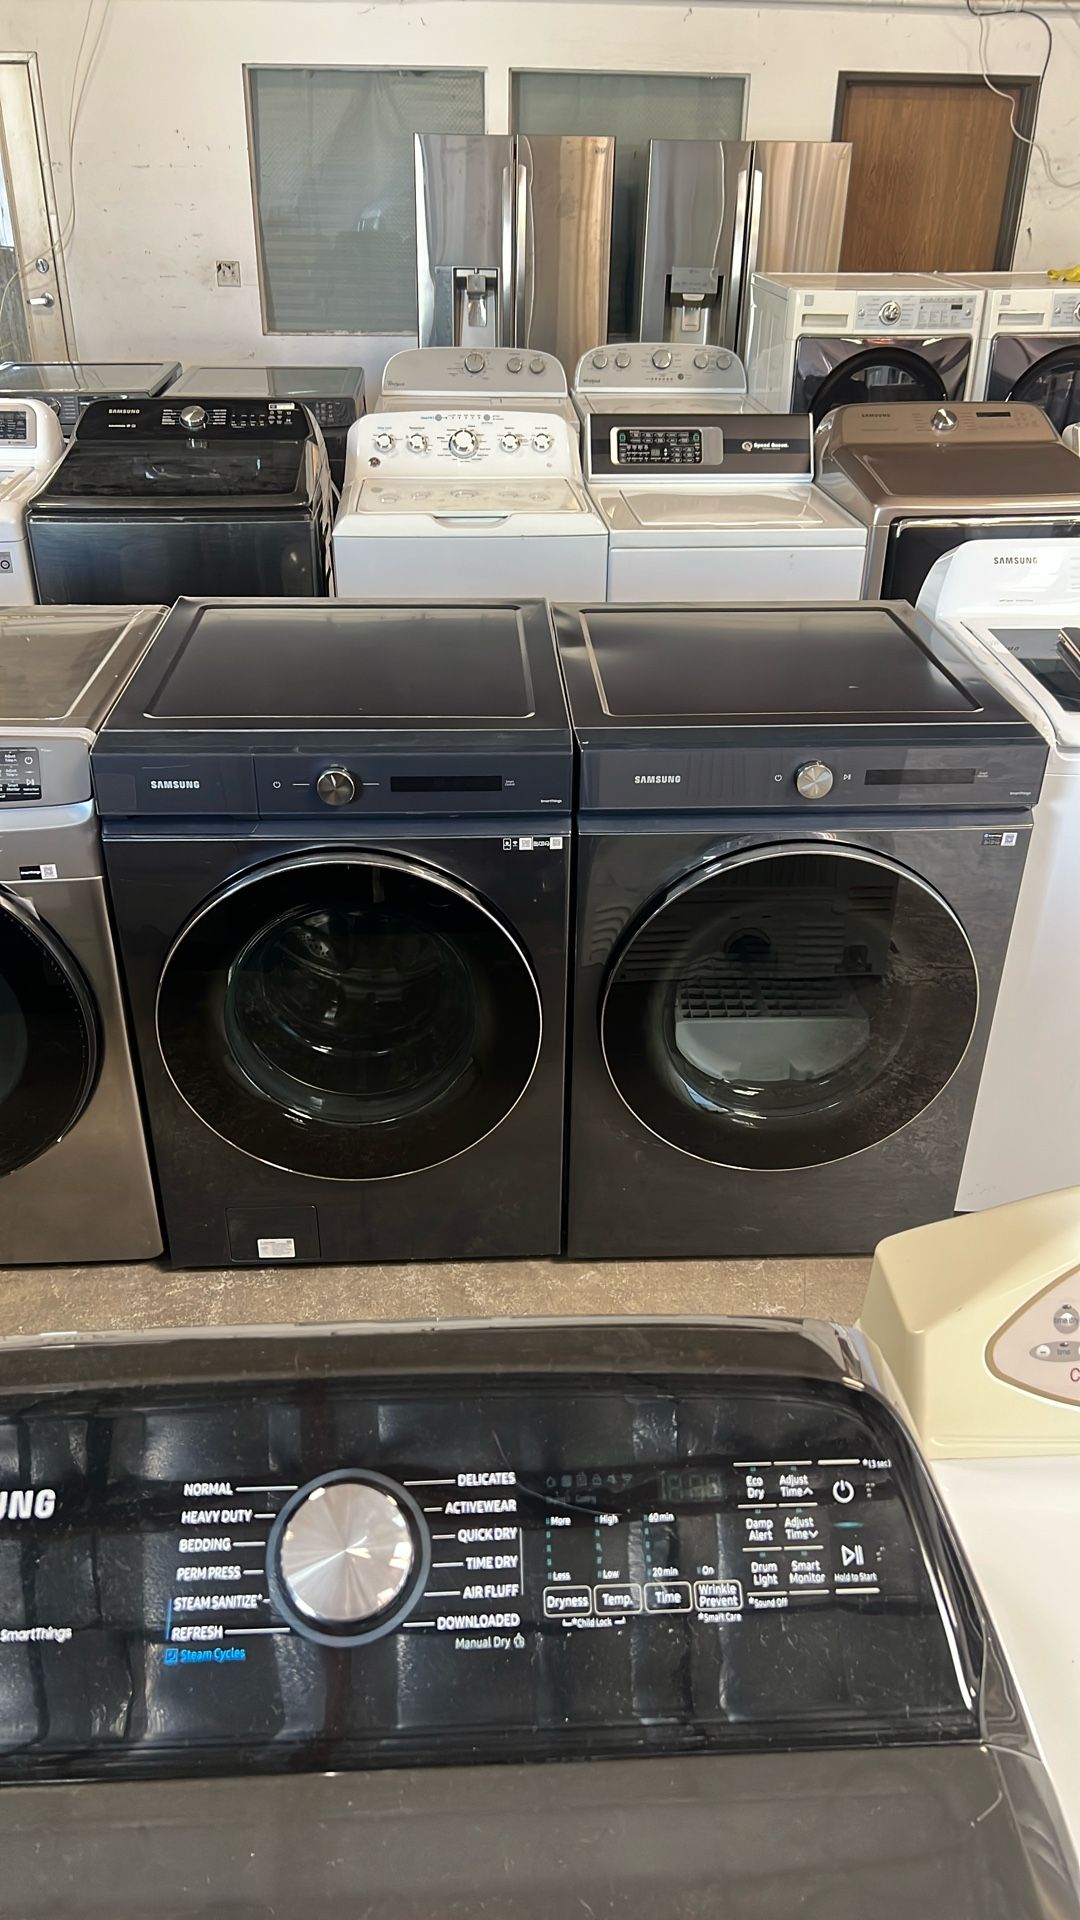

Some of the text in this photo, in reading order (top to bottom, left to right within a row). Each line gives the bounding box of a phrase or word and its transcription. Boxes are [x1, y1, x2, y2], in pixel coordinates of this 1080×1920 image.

[993, 557, 1038, 565] SAMSUNG
[150, 780, 200, 789] SAMSUNG
[634, 775, 681, 784] SAMSUNG
[457, 1472, 517, 1487] DELICATES
[745, 1475, 764, 1487] Eco
[779, 1474, 809, 1489] Adjust
[183, 1482, 234, 1496] NORMAL
[747, 1487, 765, 1500] Dry
[780, 1486, 803, 1497] Time
[444, 1499, 517, 1515] ACTIVEWEAR
[181, 1509, 253, 1524] HEAVY DUTY
[550, 1516, 572, 1526] More
[599, 1514, 619, 1527] High
[648, 1512, 675, 1523] 60 min
[784, 1516, 815, 1530] Adjust
[745, 1518, 774, 1531] Damp
[457, 1527, 518, 1544] QUICK DRY
[749, 1530, 774, 1541] Alert
[785, 1528, 808, 1540] Time
[178, 1537, 232, 1553] BEDDING
[465, 1555, 519, 1570] TIME DRY
[750, 1561, 779, 1574] Drum
[790, 1559, 822, 1573] Smart
[176, 1565, 242, 1581] PERM PRESS
[552, 1571, 572, 1582] Less
[602, 1569, 620, 1580] Low
[652, 1566, 680, 1577] 20 min
[702, 1565, 715, 1576] On
[834, 1571, 878, 1583] Hold to Start
[753, 1573, 779, 1588] Light
[788, 1571, 826, 1585] Monitor
[462, 1584, 520, 1599] AIR FLUFF
[698, 1582, 738, 1596] Wrinkle
[173, 1596, 211, 1612] STEAM
[546, 1595, 590, 1611] Dryness
[601, 1592, 634, 1608] Temp.
[655, 1591, 682, 1604] Time
[699, 1595, 739, 1608] Prevent
[775, 1596, 789, 1607] Off
[436, 1613, 521, 1631] DOWNLOADED
[595, 1617, 613, 1628] Lock
[725, 1611, 743, 1622] Care
[0, 1626, 73, 1643] SmartThings
[171, 1625, 224, 1642] REFRESH
[455, 1636, 511, 1650] Manual Dry
[180, 1647, 246, 1663] Steam Cycles
